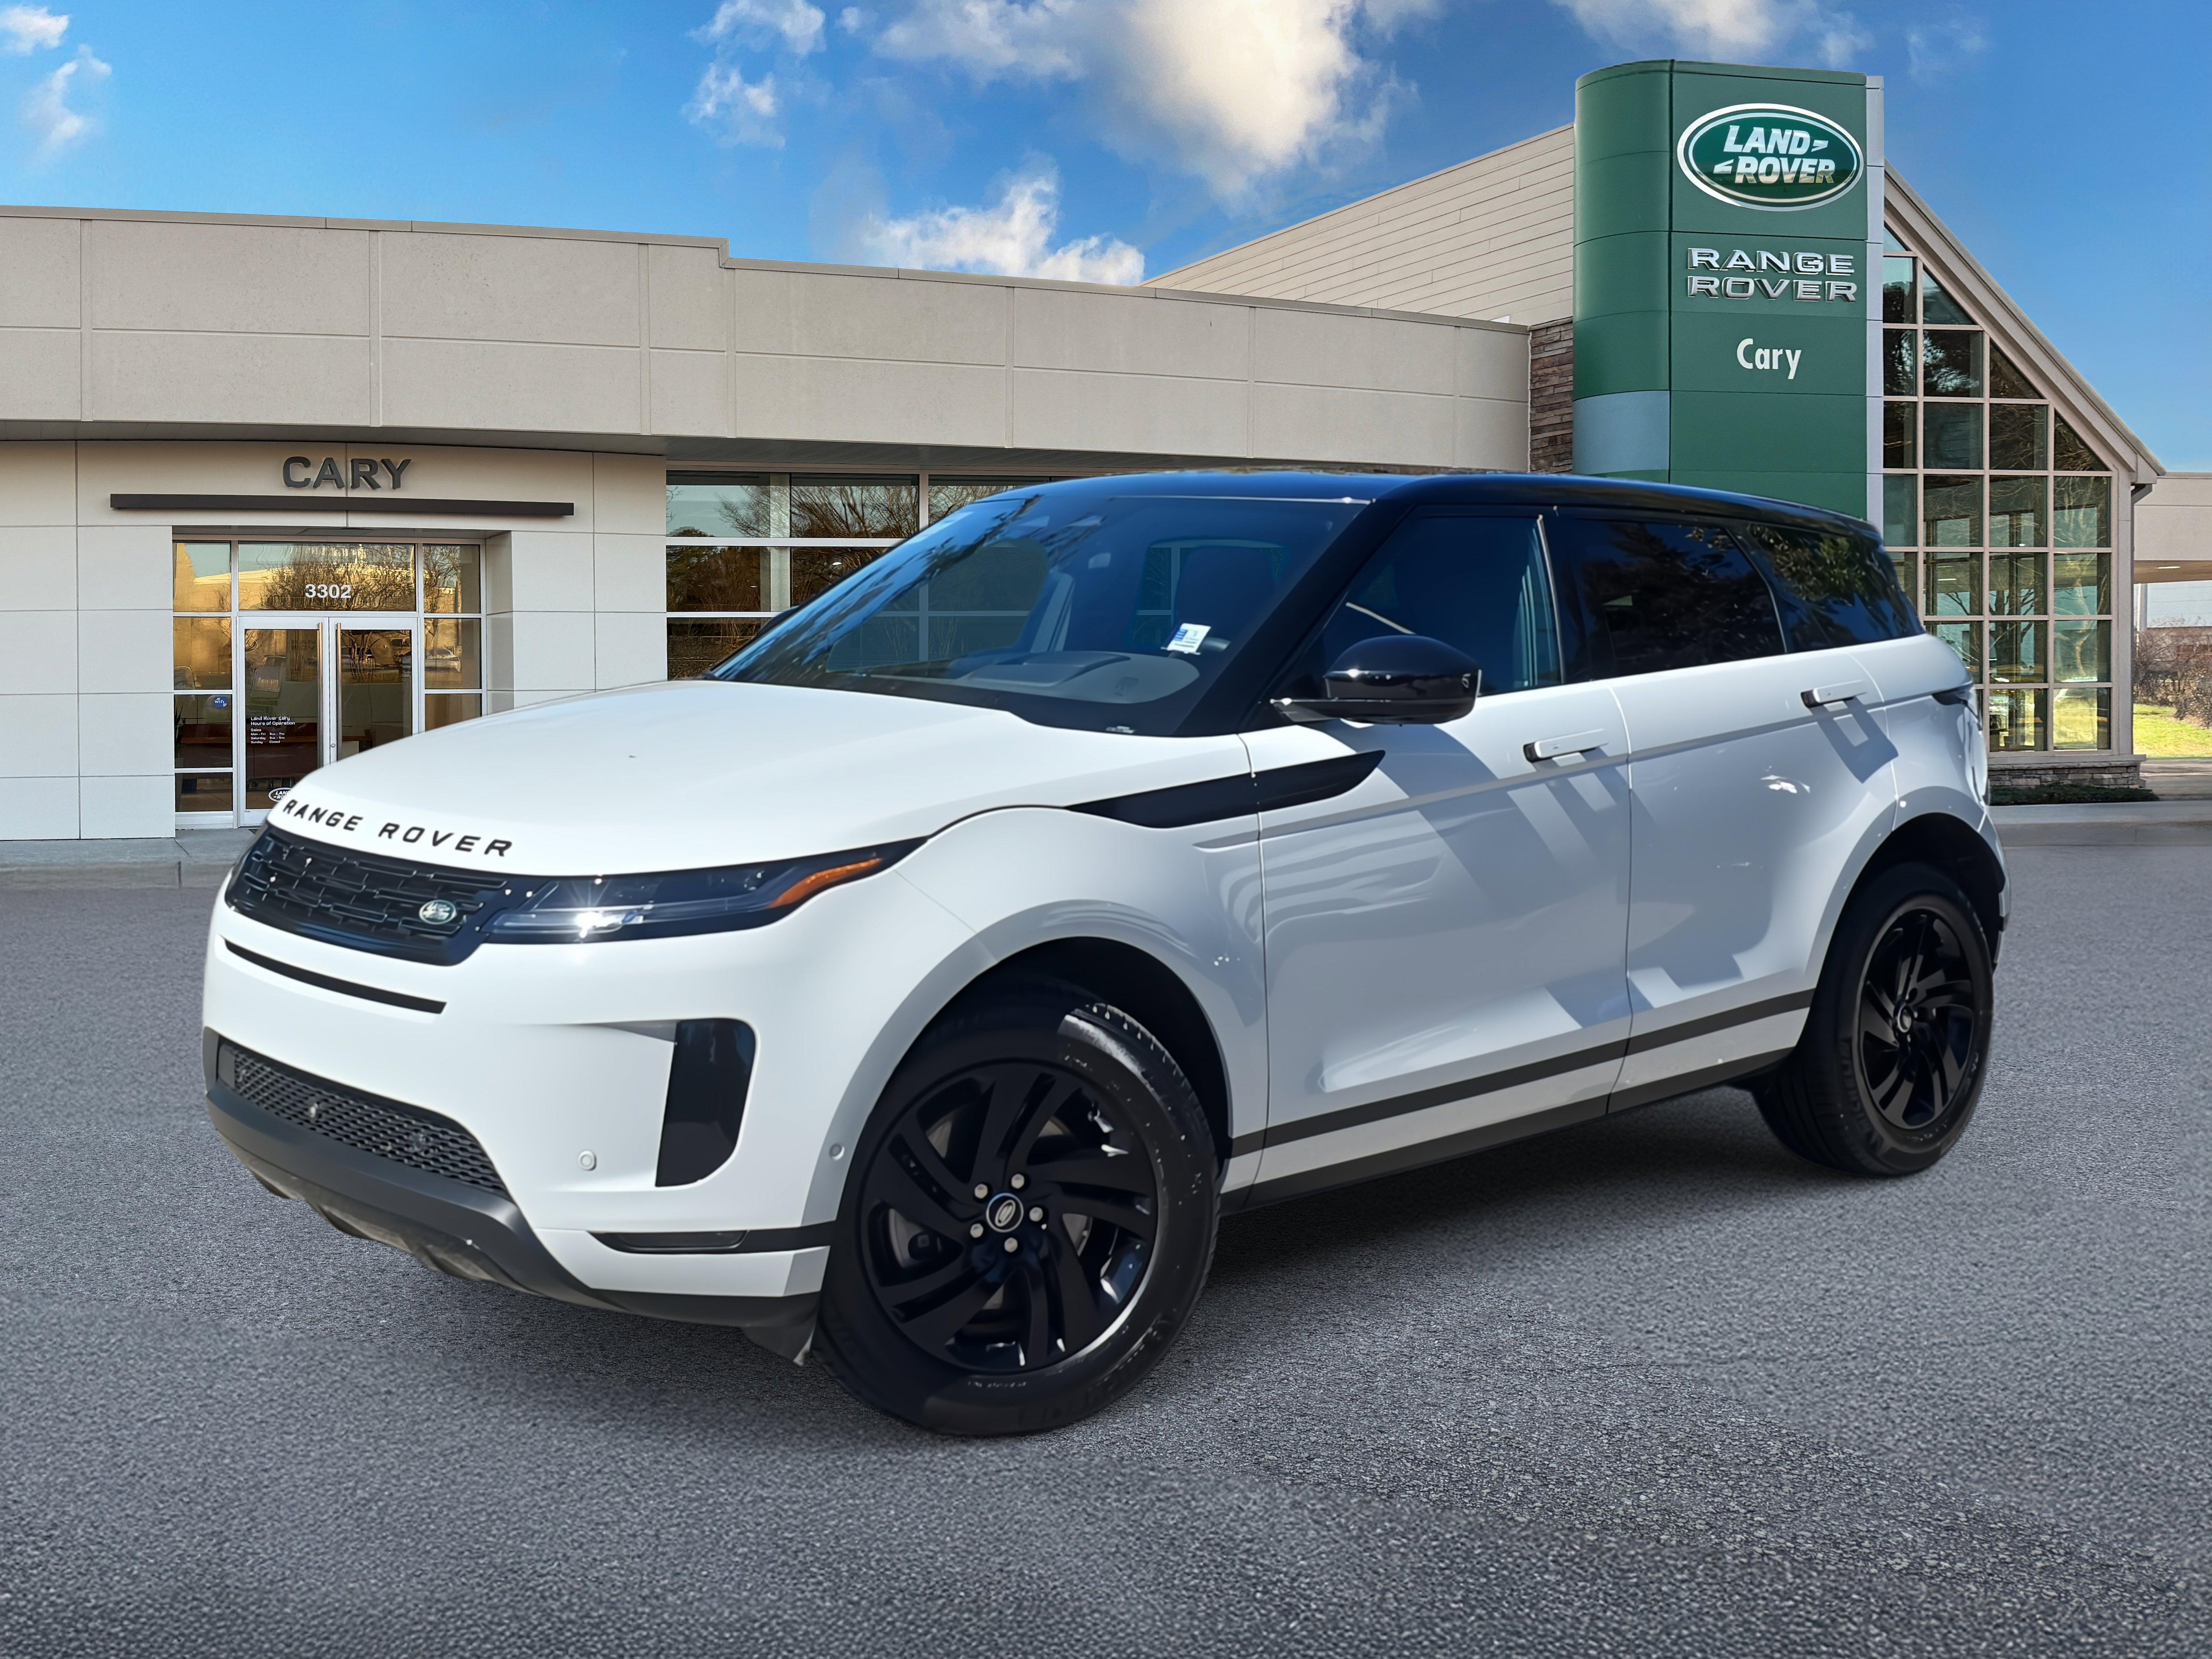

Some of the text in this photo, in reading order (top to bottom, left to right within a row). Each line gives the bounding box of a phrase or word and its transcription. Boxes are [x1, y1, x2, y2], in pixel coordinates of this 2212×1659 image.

[1723, 125, 1810, 155] LAND
[1735, 156, 1835, 183] ROVER
[1687, 248, 1855, 276] RANGE
[1687, 276, 1857, 302] ROVER
[1736, 338, 1802, 380] Cary
[283, 456, 412, 489] CARY
[305, 584, 352, 598] 3302
[283, 799, 512, 857] RANGE ROVER
